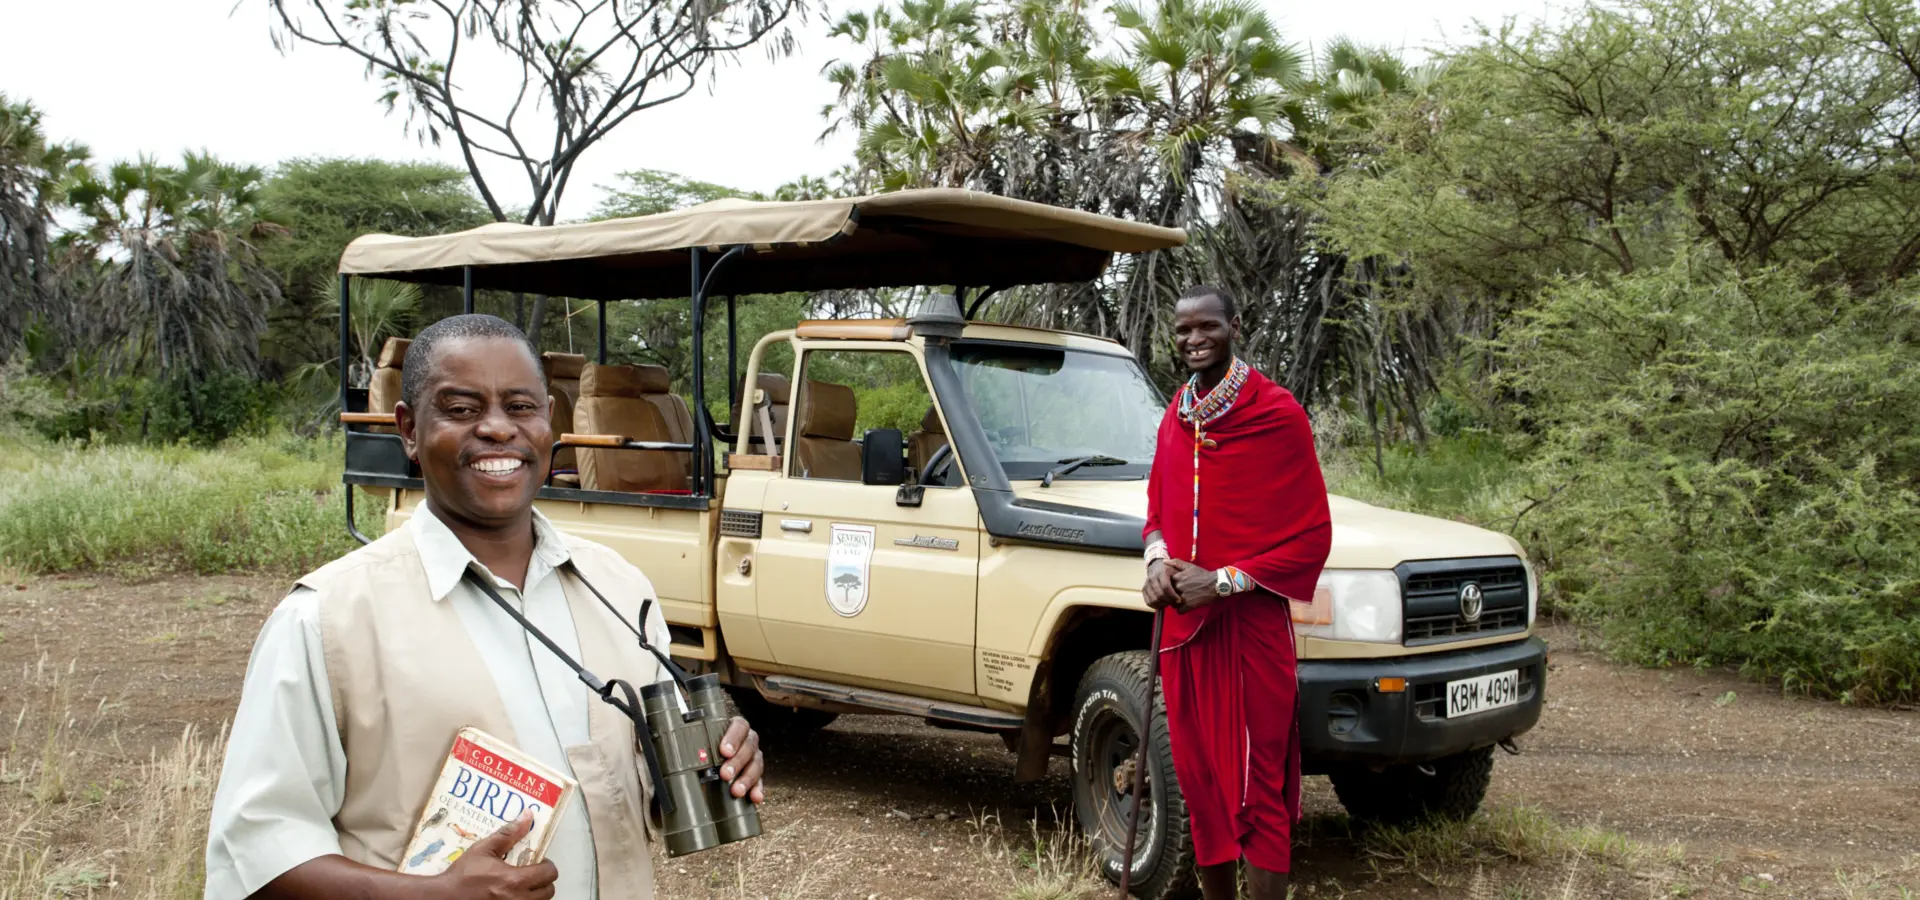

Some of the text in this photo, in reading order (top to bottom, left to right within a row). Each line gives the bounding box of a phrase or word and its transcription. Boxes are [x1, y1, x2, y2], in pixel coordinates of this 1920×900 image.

[1102, 689, 1118, 702] T/A
[1450, 673, 1518, 714] KBM 409W
[469, 758, 543, 798] ILLUSTRATED CHECKLIST
[472, 749, 546, 792] COLLINS
[440, 794, 452, 806] OF
[453, 800, 497, 828] EASTERN
